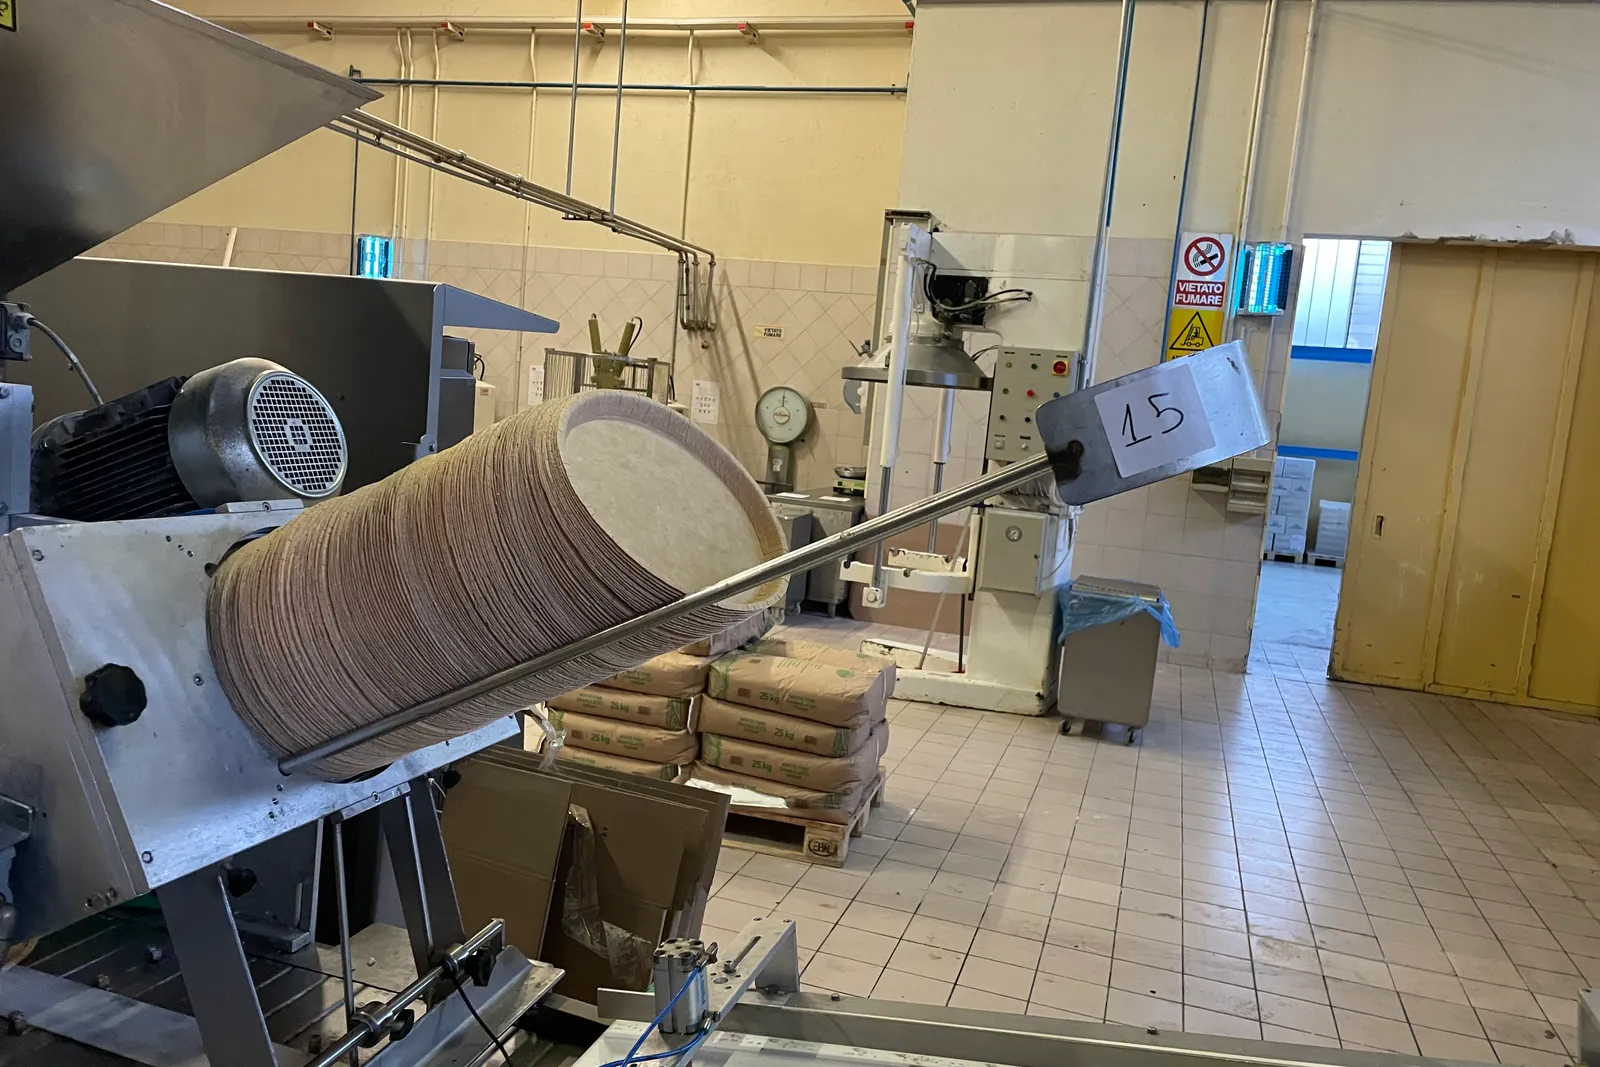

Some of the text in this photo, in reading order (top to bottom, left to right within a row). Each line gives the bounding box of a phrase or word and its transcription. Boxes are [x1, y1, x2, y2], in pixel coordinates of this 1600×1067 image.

[1179, 282, 1223, 293] VIETATO
[1176, 294, 1222, 305] FUMARE
[759, 691, 780, 705] 25 kg
[610, 701, 630, 713] 25 kg
[590, 733, 610, 745] 25 kg
[774, 727, 795, 741] 25 kg
[751, 759, 772, 772] 25 kg
